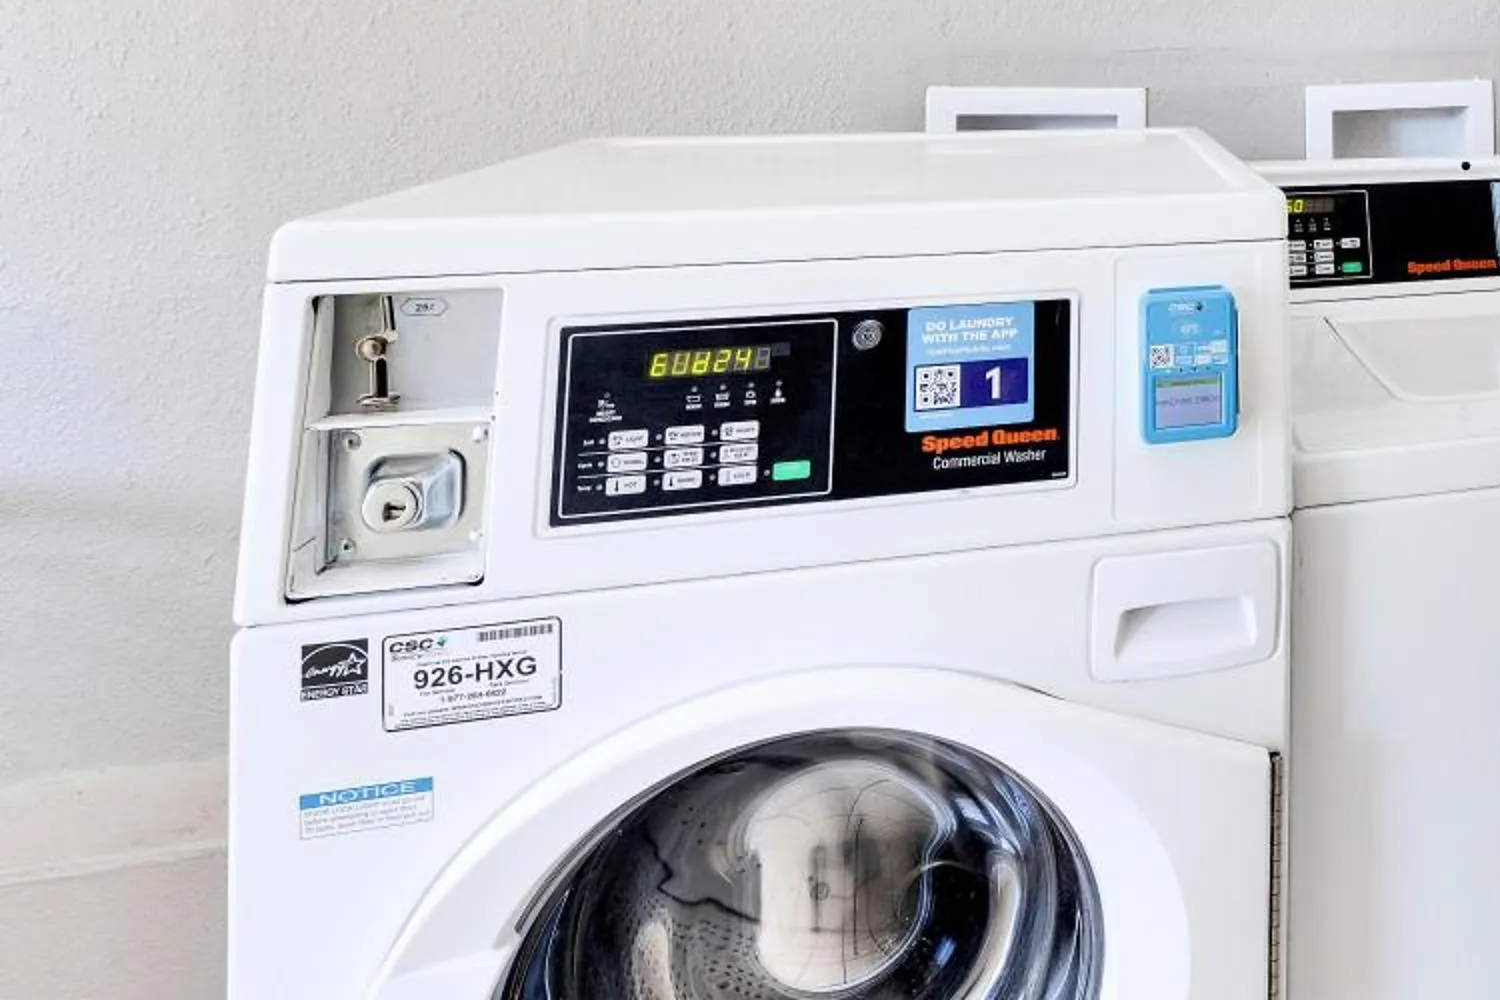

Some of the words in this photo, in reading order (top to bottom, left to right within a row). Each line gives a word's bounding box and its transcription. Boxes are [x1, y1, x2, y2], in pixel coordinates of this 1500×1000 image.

[1407, 259, 1451, 275] Speed
[925, 320, 946, 331] DO
[949, 316, 1014, 330] LAUNDRY
[921, 332, 958, 344] WITH
[960, 331, 988, 341] THE
[991, 327, 1019, 339] APP
[985, 365, 1002, 399] 1
[921, 431, 989, 454] Speed
[991, 427, 1059, 450] Queen
[932, 449, 1001, 471] Commercial
[1003, 448, 1048, 465] Washer
[389, 638, 435, 653] CSC
[413, 656, 538, 690] 926-HXG
[319, 781, 417, 805] NOTICE
